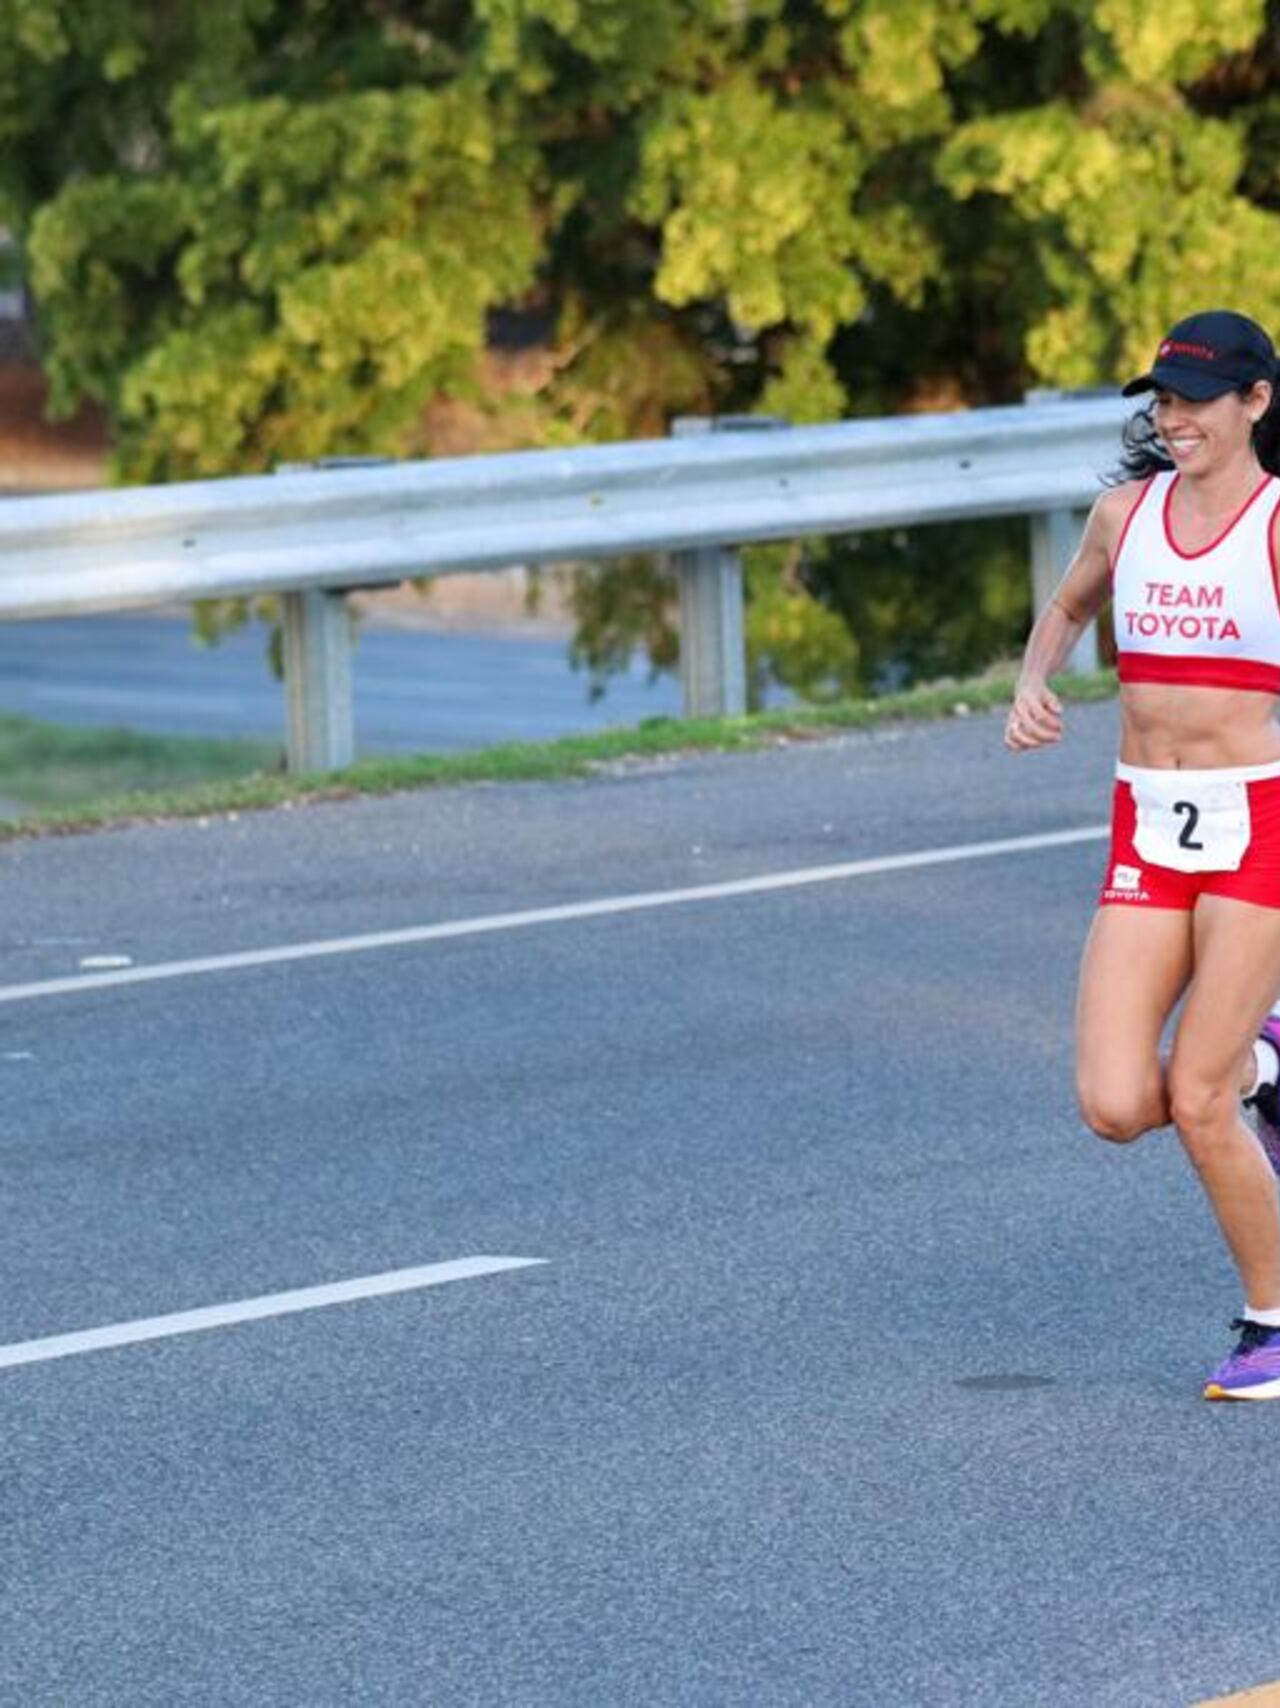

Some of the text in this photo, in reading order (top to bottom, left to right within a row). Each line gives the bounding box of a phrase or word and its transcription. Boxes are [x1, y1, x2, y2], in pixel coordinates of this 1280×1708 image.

[1145, 582, 1224, 608] TEAM
[1125, 611, 1241, 640] TOYOTA
[1173, 801, 1203, 850] 2
